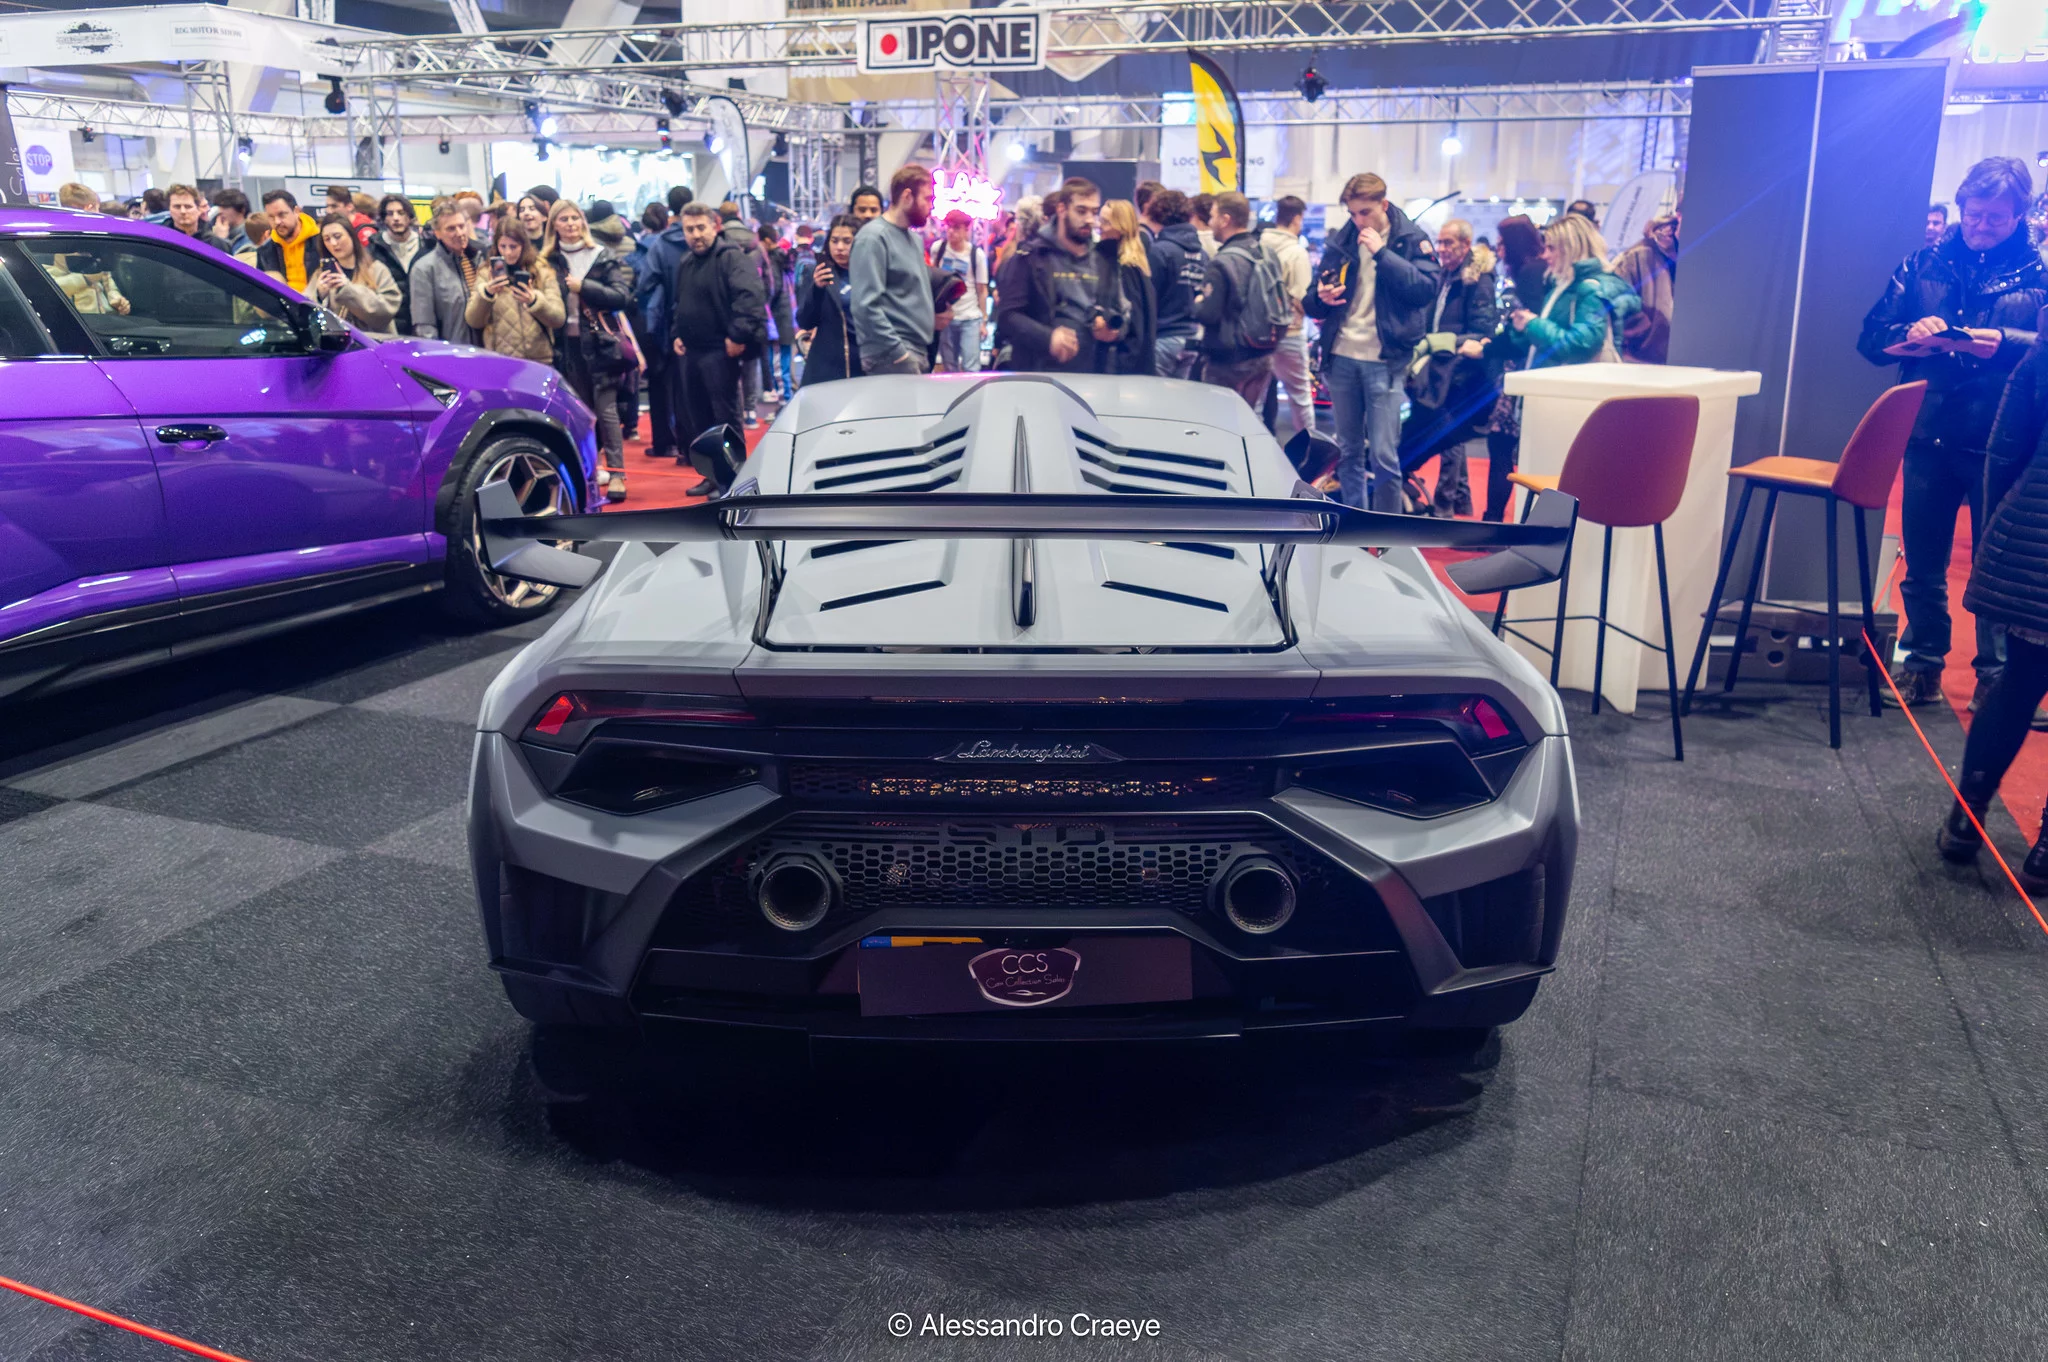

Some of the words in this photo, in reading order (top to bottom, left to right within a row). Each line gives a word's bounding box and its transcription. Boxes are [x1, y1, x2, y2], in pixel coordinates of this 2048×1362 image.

[907, 23, 1031, 60] IPONE
[26, 152, 51, 167] STOP
[957, 740, 1091, 763] Lamborghini
[1001, 952, 1049, 975] CCS
[985, 977, 1004, 989] Car
[1005, 976, 1042, 987] Collection
[1044, 974, 1065, 985] Sales
